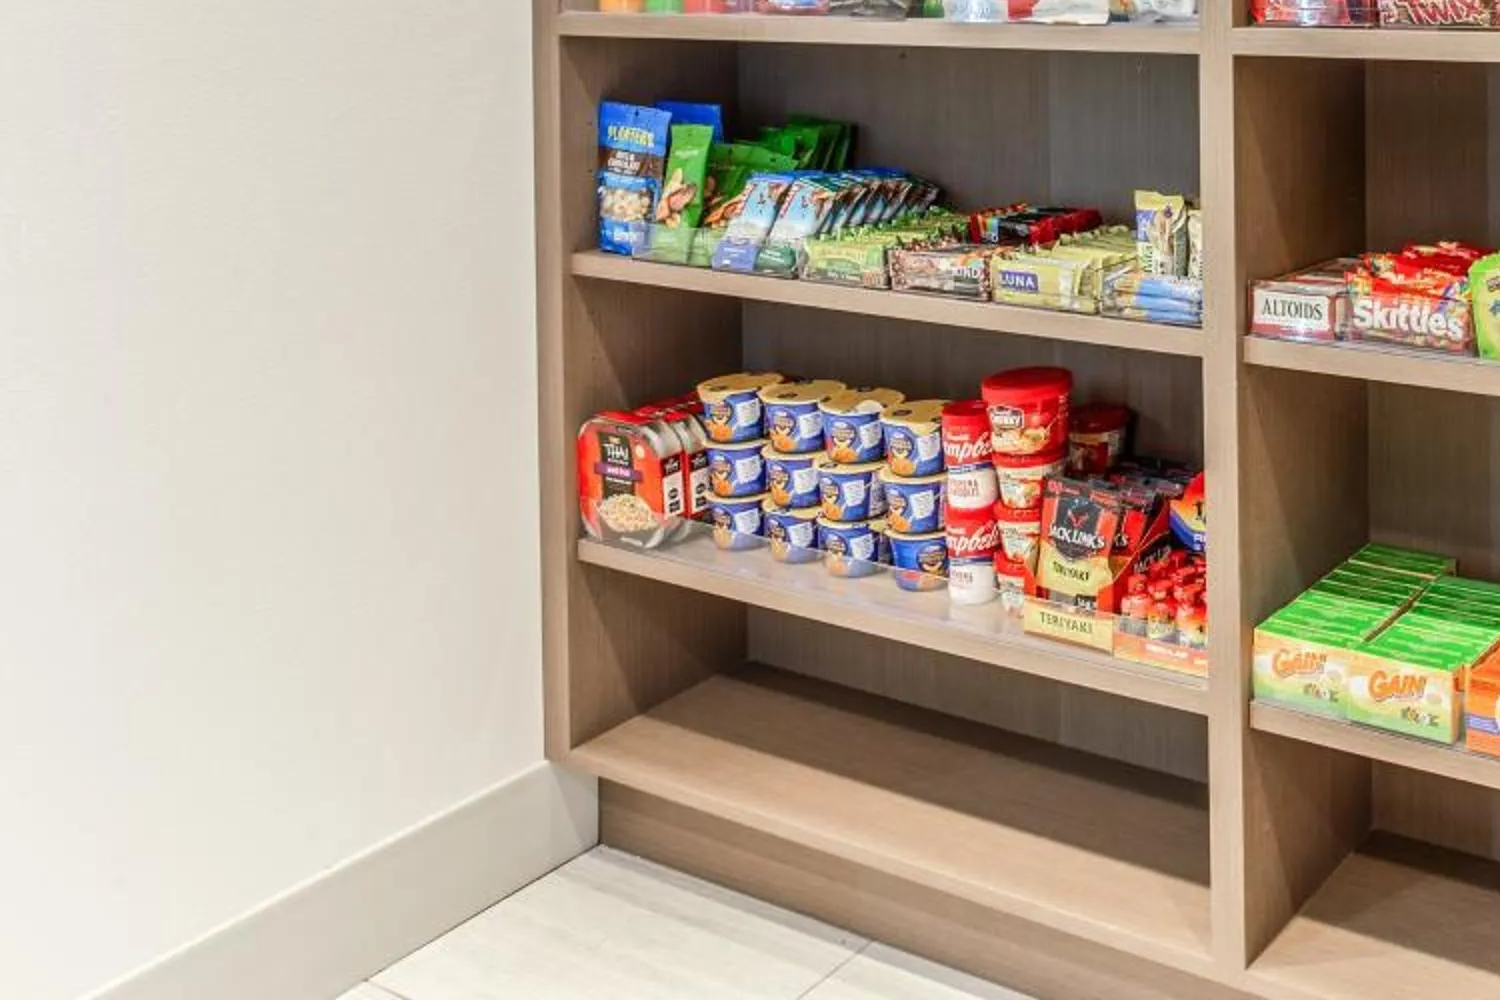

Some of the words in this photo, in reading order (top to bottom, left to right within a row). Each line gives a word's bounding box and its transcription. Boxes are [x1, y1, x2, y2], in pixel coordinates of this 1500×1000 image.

[999, 271, 1036, 289] LUNA
[1261, 298, 1324, 321] ALTOIDS
[1352, 298, 1465, 343] Skittles
[1040, 612, 1093, 634] TERIYAKI
